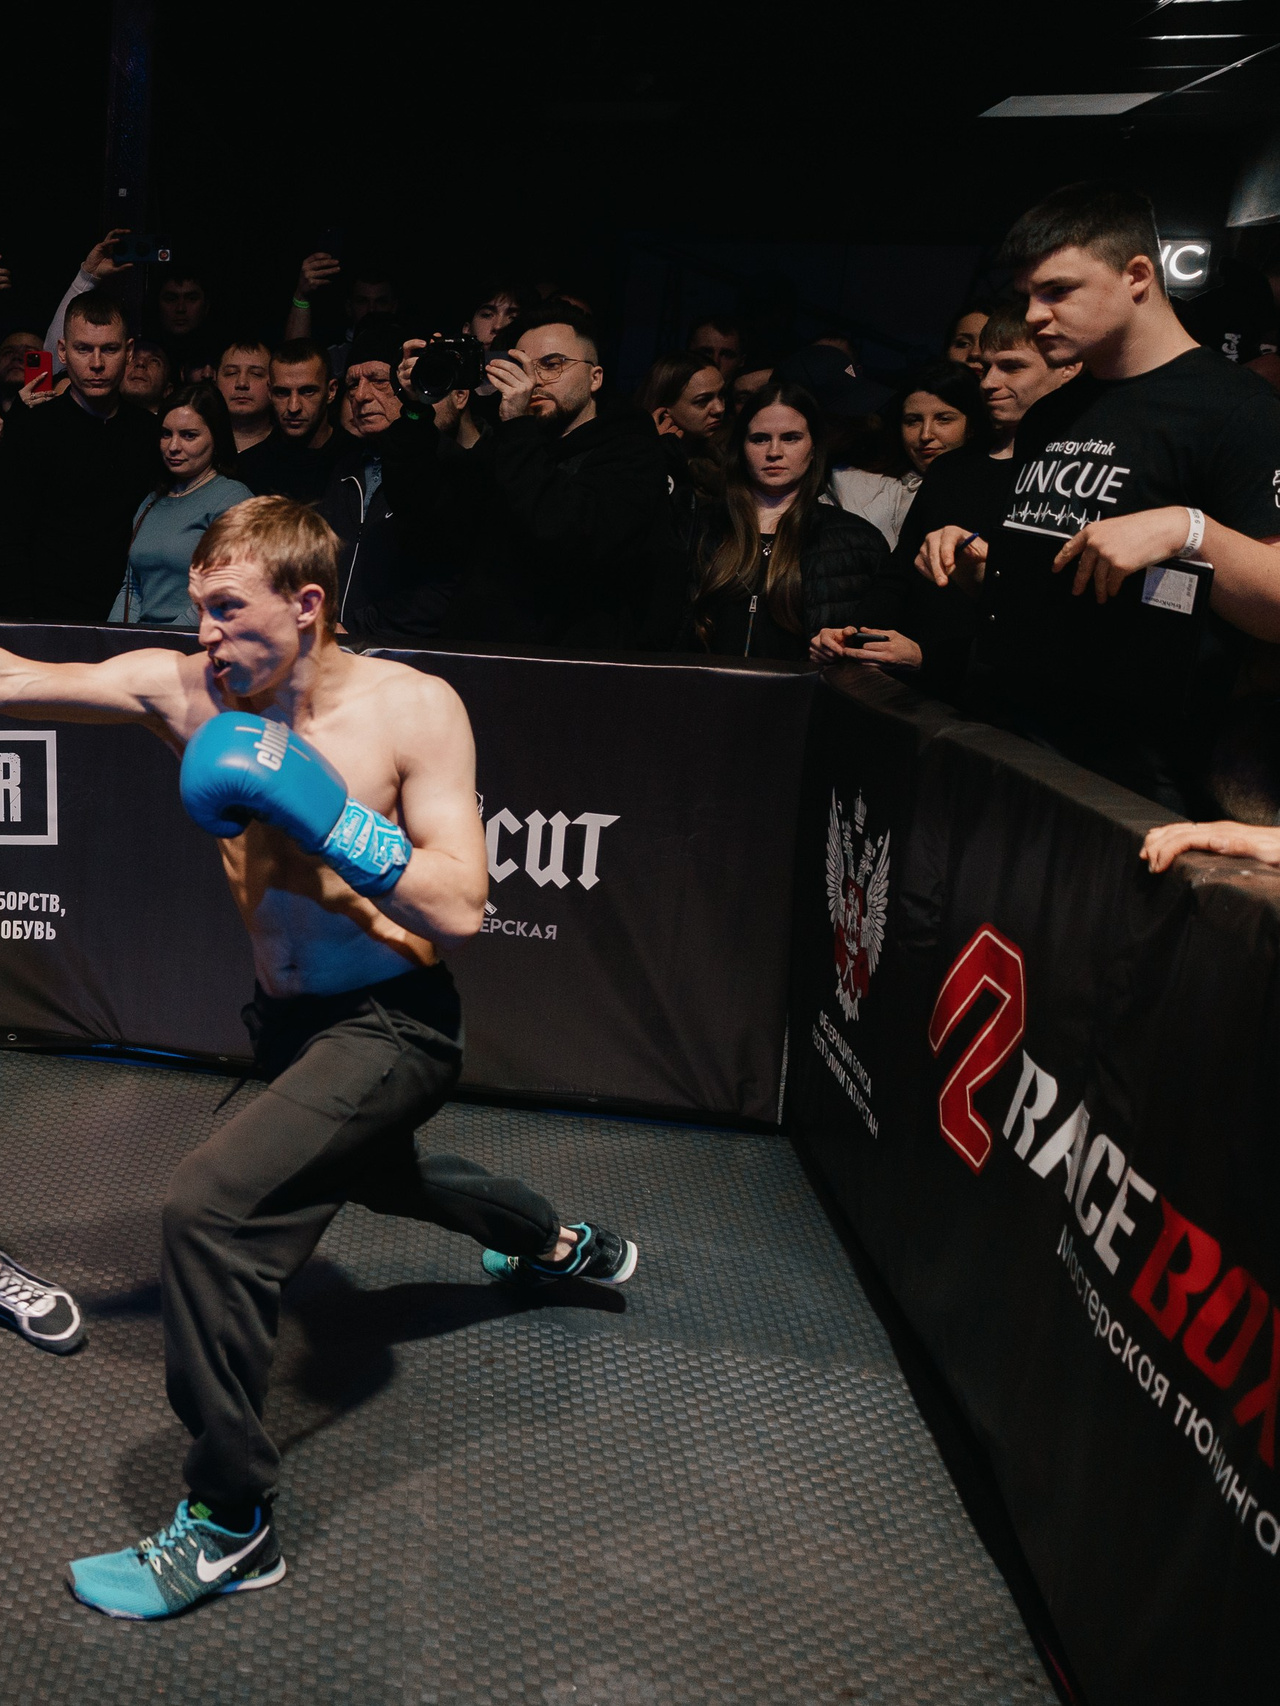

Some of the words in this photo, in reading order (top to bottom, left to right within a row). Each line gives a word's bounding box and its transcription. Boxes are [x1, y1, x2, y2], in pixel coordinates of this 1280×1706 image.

[1161, 244, 1206, 281] C
[1082, 438, 1116, 456] drink
[0, 919, 57, 941] ОБУВЬ
[1056, 1224, 1171, 1408] Мастерская
